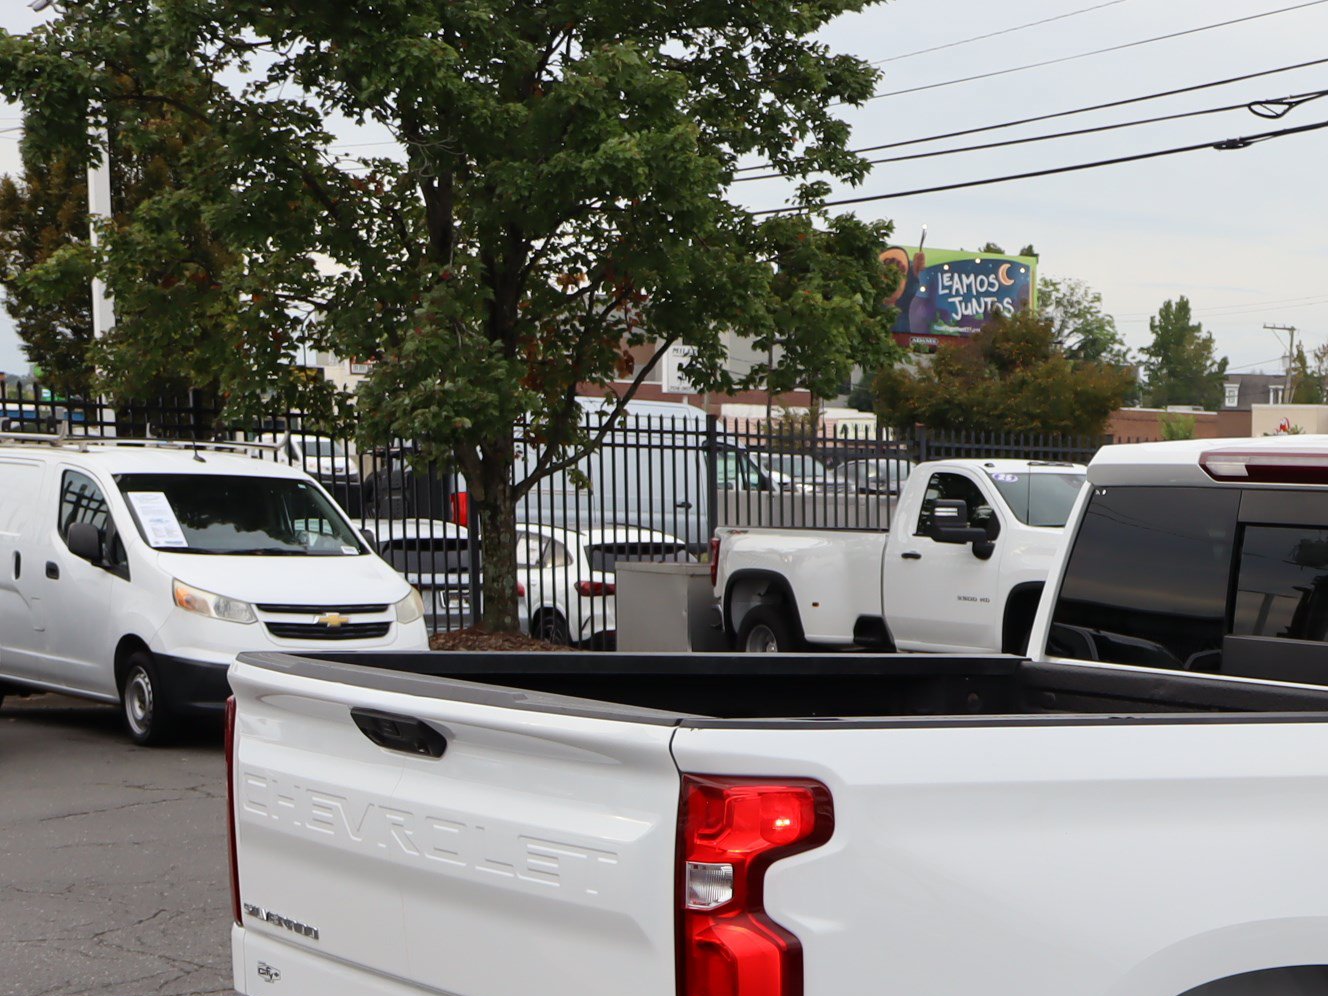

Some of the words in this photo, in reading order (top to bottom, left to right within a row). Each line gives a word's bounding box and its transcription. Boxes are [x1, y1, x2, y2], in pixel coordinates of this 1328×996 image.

[937, 271, 999, 295] LEAMOS
[243, 771, 619, 894] CHEVROLET
[243, 902, 319, 940] SILVERADO
